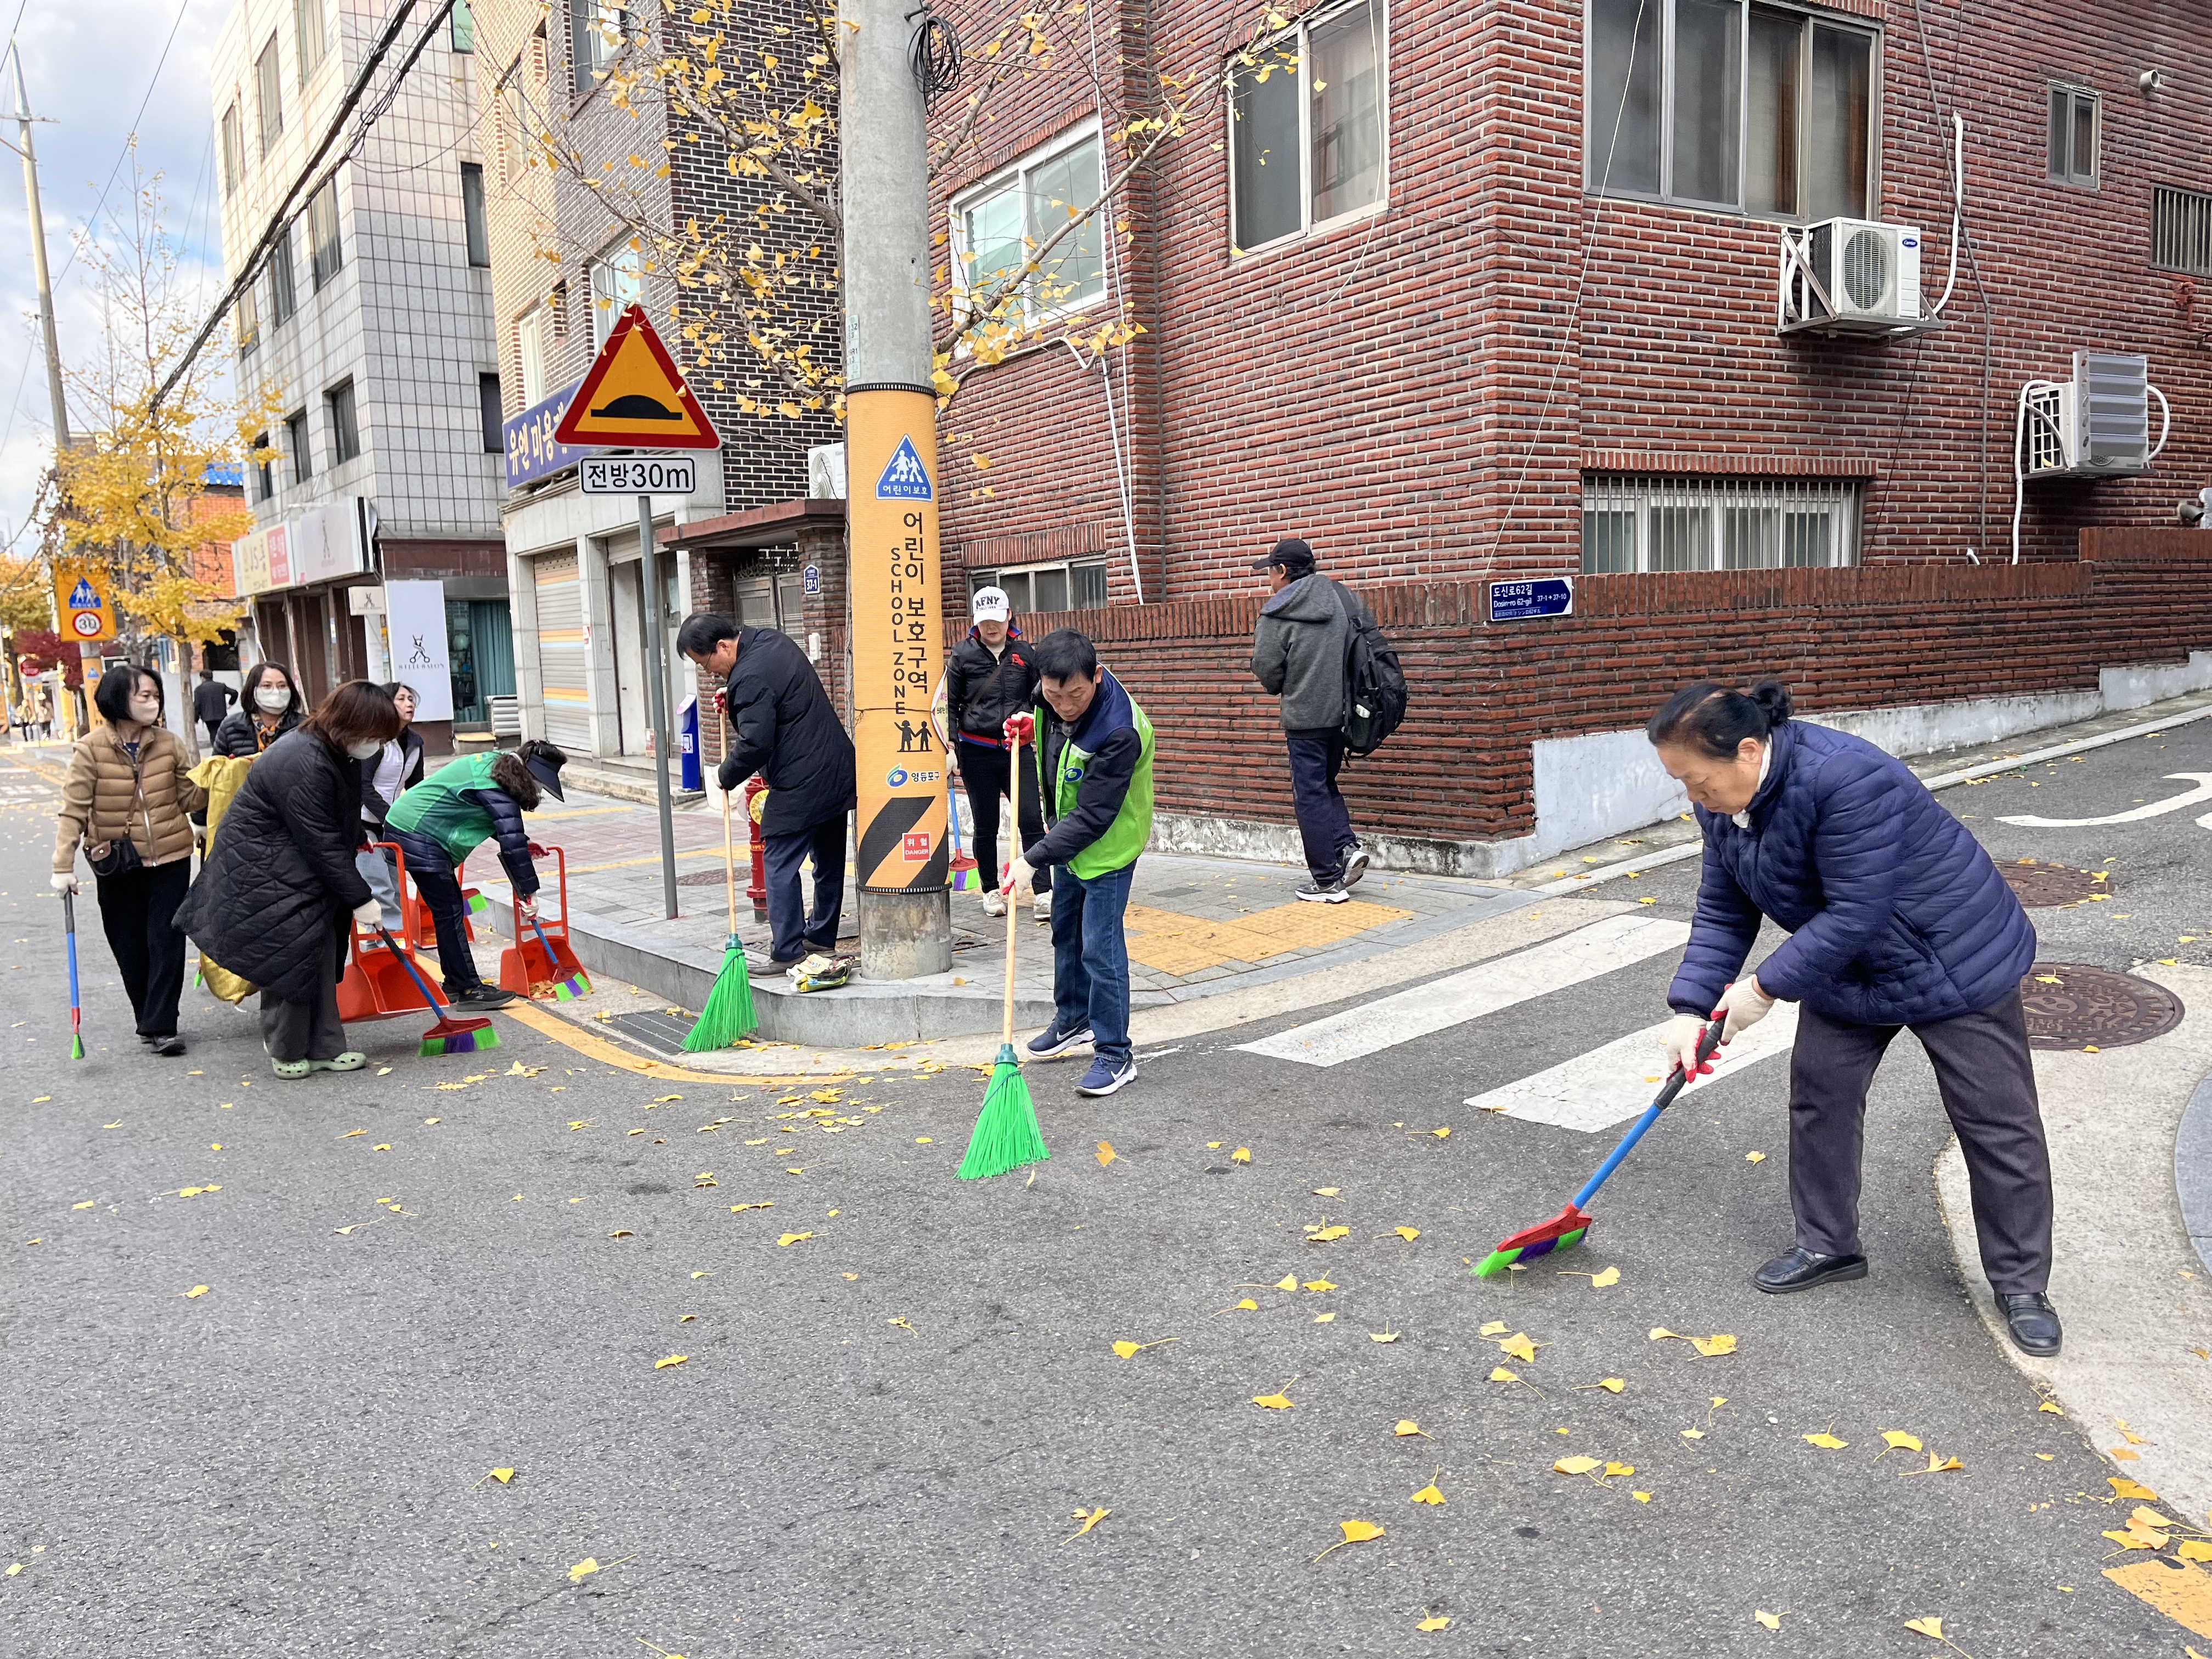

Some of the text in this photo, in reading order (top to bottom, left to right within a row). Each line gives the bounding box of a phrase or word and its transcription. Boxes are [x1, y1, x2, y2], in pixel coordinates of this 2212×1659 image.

[509, 422, 529, 476] 유엔
[588, 463, 689, 488] 전방30m
[883, 485, 928, 495] 어린이보호
[806, 579, 817, 590] 37-1
[1493, 584, 1532, 597] 도신로62길
[903, 512, 928, 693] 어린이 보호구역
[975, 595, 1000, 610] AFNY
[1493, 597, 1532, 608] Dosin-ro 62-gil
[78, 618, 97, 630] 30
[891, 547, 906, 714] SCHOOL ZONE
[911, 771, 940, 782] 영등포구
